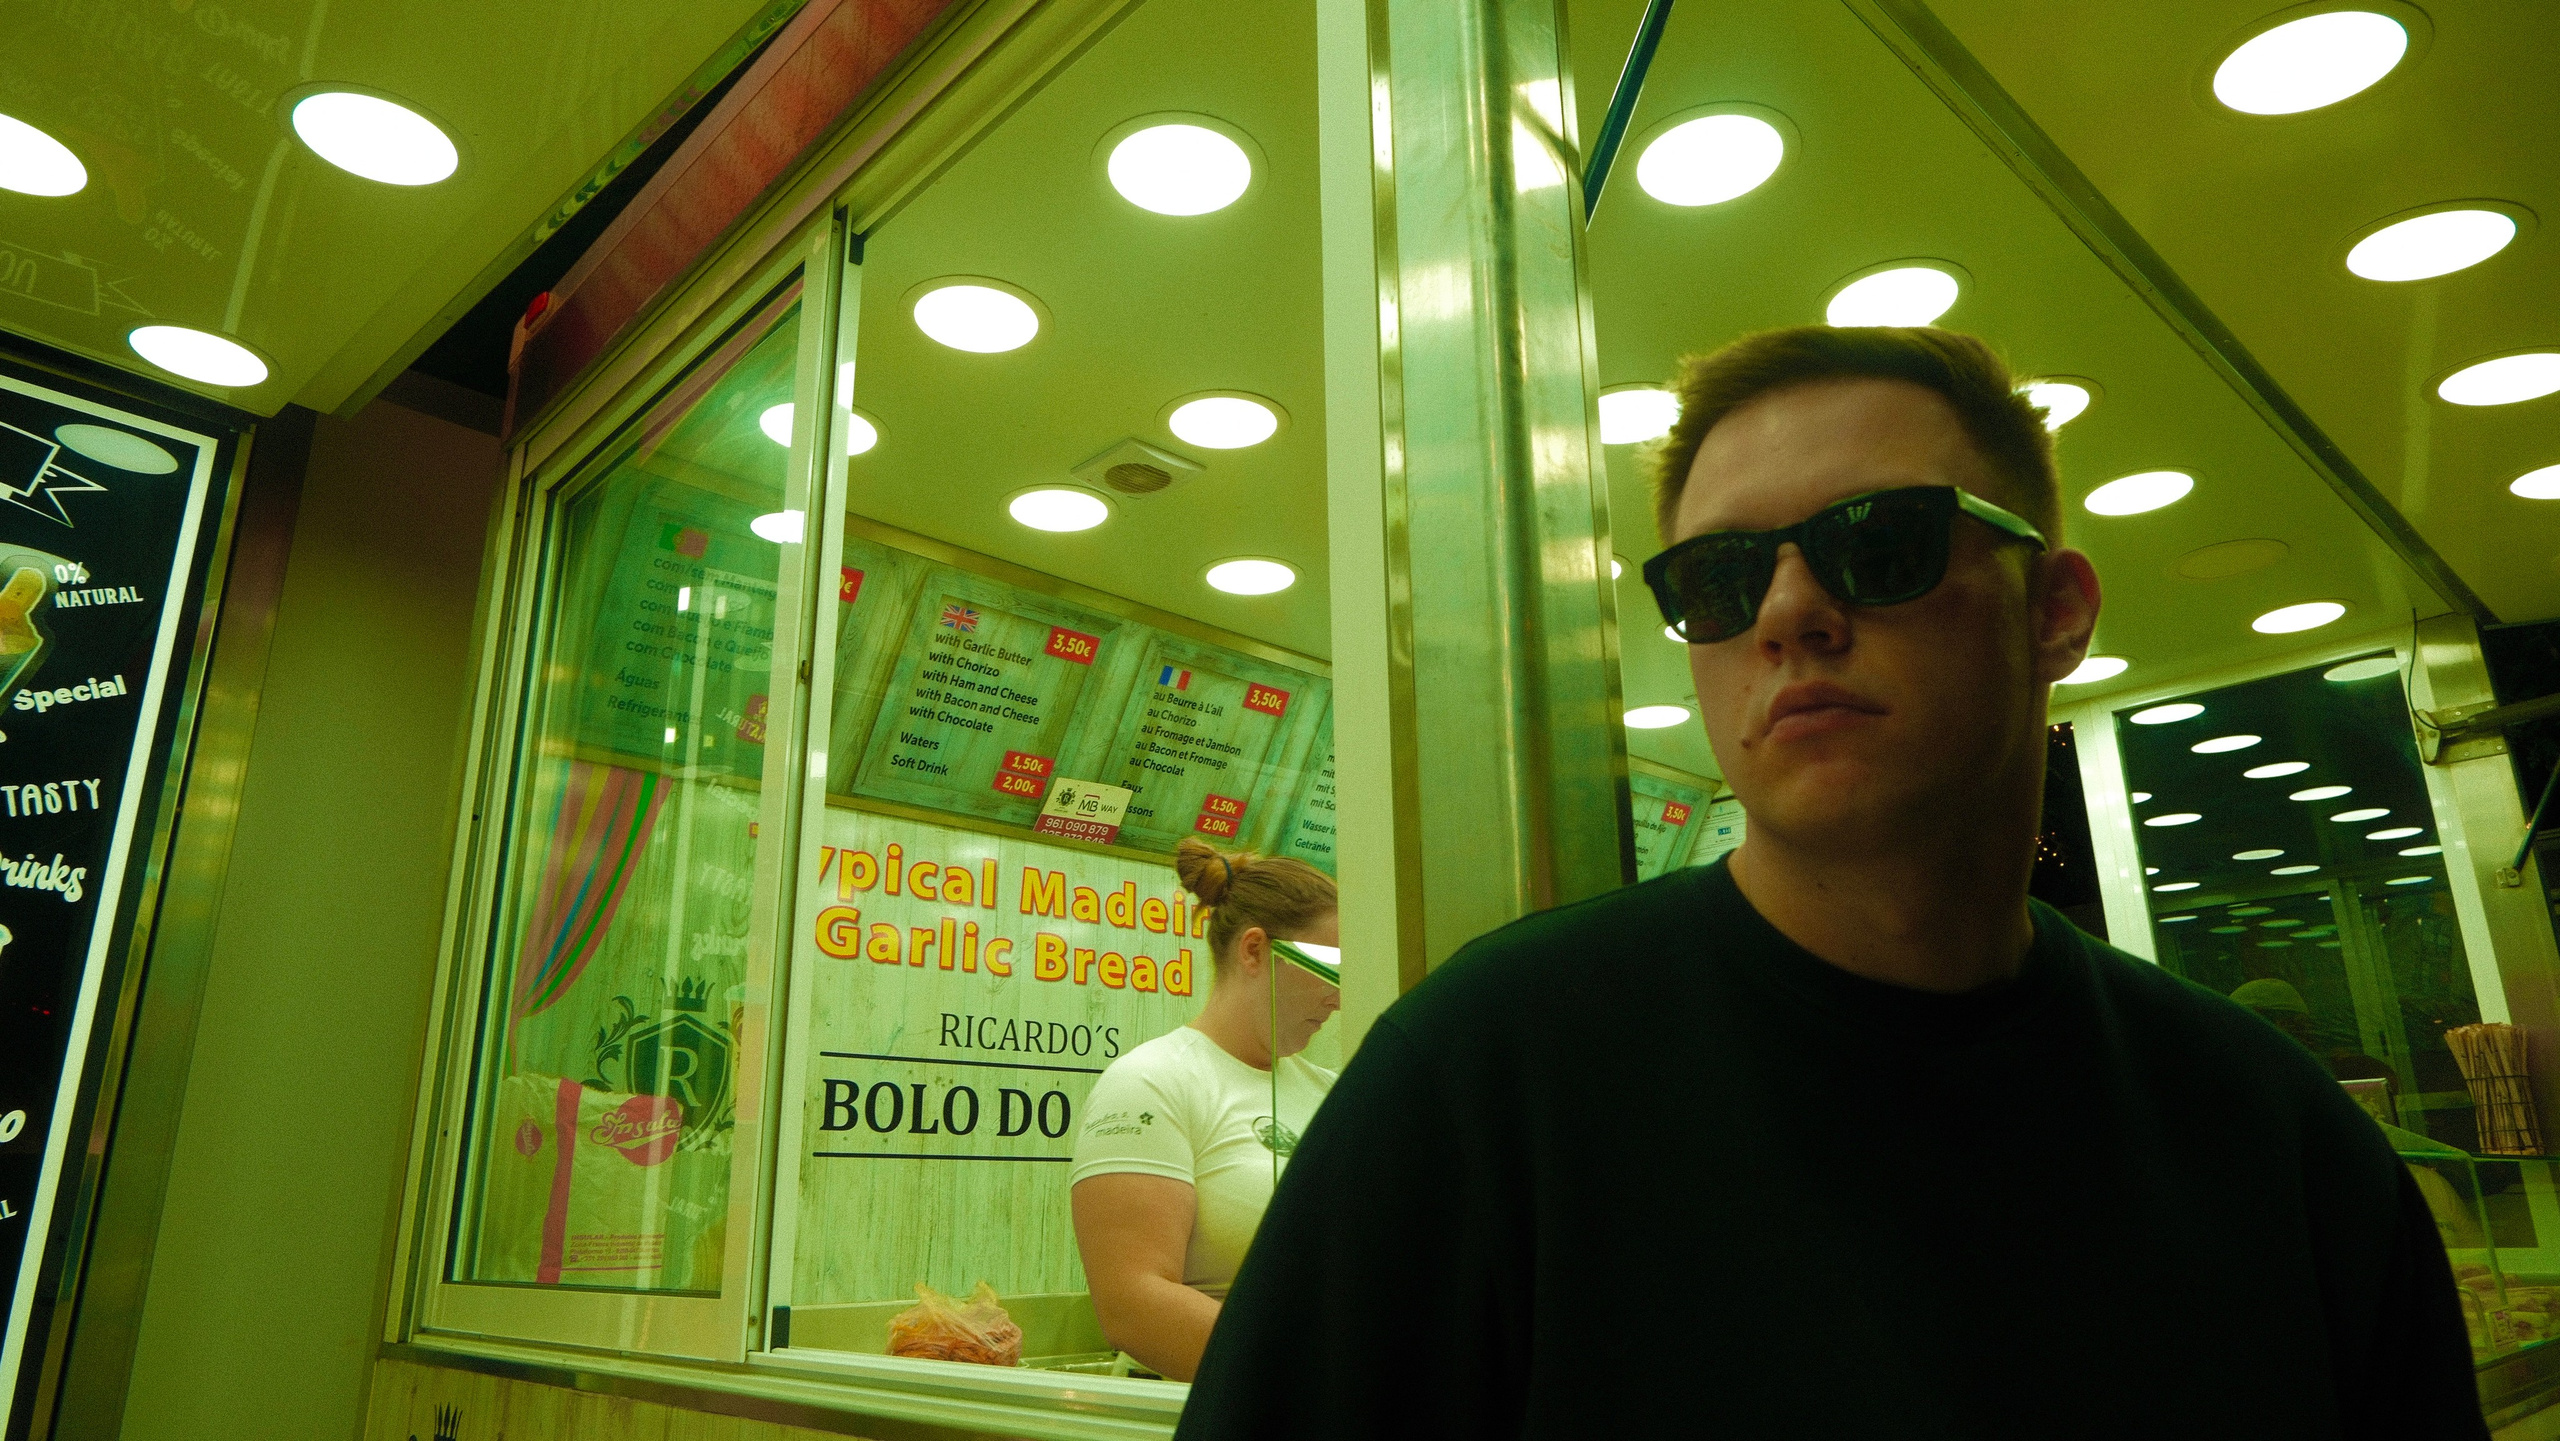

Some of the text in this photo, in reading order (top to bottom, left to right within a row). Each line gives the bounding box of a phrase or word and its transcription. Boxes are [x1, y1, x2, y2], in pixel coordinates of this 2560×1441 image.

[55, 562, 86, 585] 0%
[55, 586, 143, 608] NATURAL
[639, 599, 671, 616] com
[632, 619, 665, 636] com
[625, 640, 658, 657] com
[935, 632, 1032, 667] with Garlic Butter
[1053, 633, 1092, 658] 3,50€
[928, 650, 1000, 677] with Chorizo
[614, 667, 660, 690] Águas
[922, 668, 1038, 707] with Ham and Cheese
[14, 674, 127, 712] Special
[1153, 690, 1166, 702] au
[1167, 693, 1198, 711] Beurre
[1250, 689, 1282, 710] 3,50€
[916, 687, 1040, 726] with Bacon and Cheese
[909, 704, 994, 734] with Chocolate
[1147, 708, 1197, 728] au Chorizo
[900, 731, 940, 750] Waters
[1141, 724, 1242, 756] au Fromage et Jambon
[891, 754, 949, 777] Soft Drink
[1011, 755, 1043, 773] 1,50€
[1135, 740, 1228, 771] au Bacon et Fromage
[1129, 756, 1185, 777] au Chocolat
[1002, 775, 1036, 794] 2,00€
[1316, 784, 1329, 794] mit
[1, 778, 100, 817] TASTY
[1078, 799, 1099, 812] MB
[1101, 804, 1119, 813] WAY
[1210, 798, 1238, 815] 1,50€
[1310, 798, 1324, 809] mit
[1666, 805, 1686, 821] 3,50€
[1045, 818, 1109, 836] 961 090 879
[1202, 817, 1230, 834] 2,00€
[1302, 819, 1330, 835] Wasser
[1295, 838, 1331, 853] Getränke
[819, 844, 1211, 939] pical Madeir
[815, 904, 1193, 997] Garlic Bread
[660, 1046, 701, 1107] R
[820, 1078, 1071, 1138] BOLO DO
